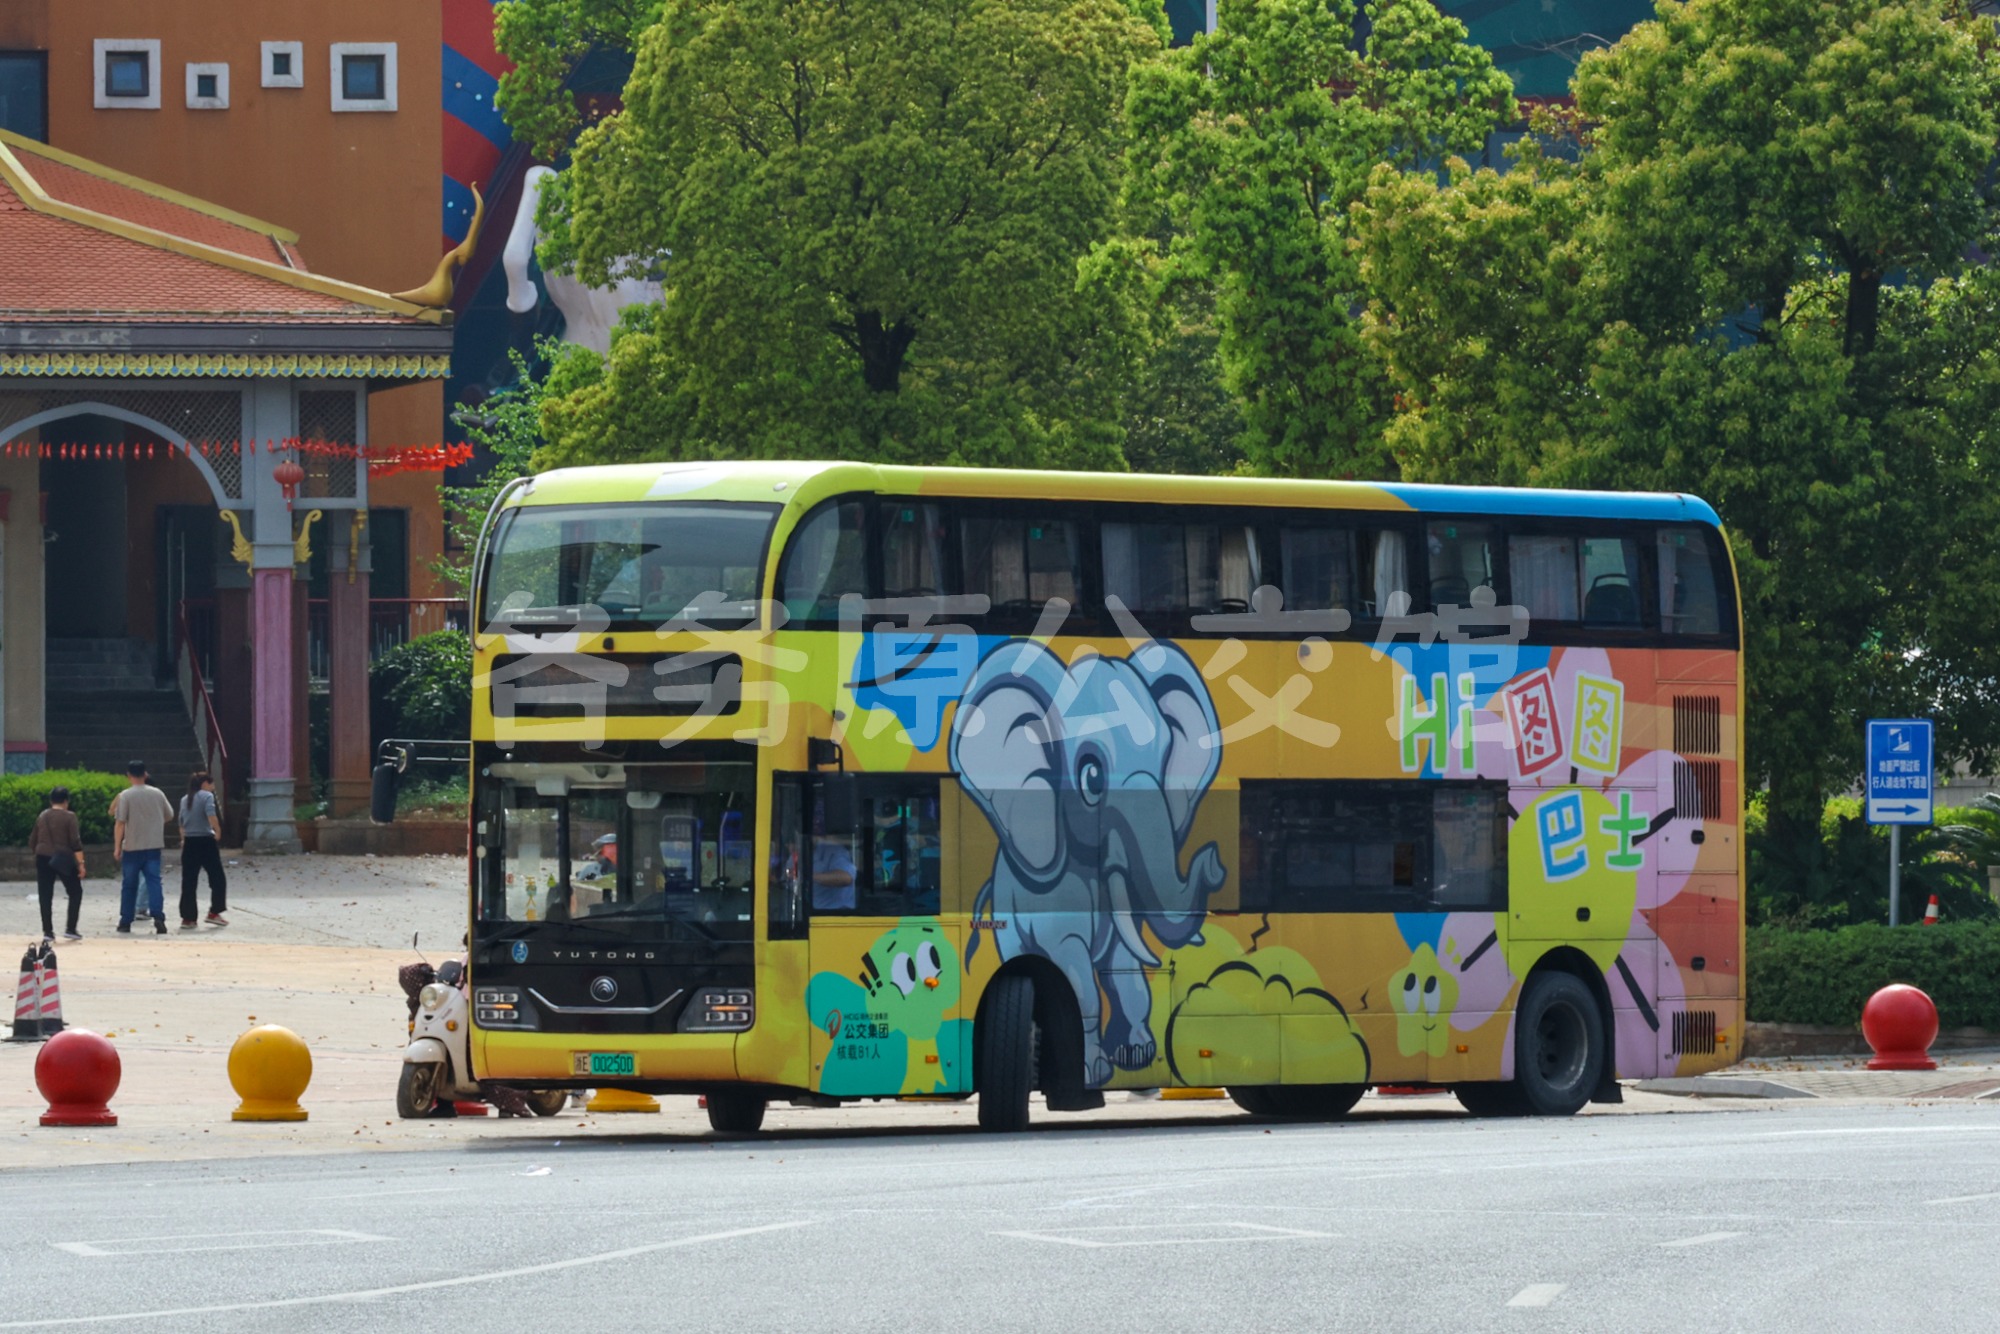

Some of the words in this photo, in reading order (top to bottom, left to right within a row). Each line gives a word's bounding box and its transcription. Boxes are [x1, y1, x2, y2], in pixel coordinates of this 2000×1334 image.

[1400, 671, 1476, 773] Hi
[1503, 667, 1624, 780] 图图
[1536, 789, 1650, 883] 巴士
[970, 921, 1007, 929] YUTONG
[553, 951, 655, 959] YUTONG
[844, 1023, 889, 1039] 公交集团
